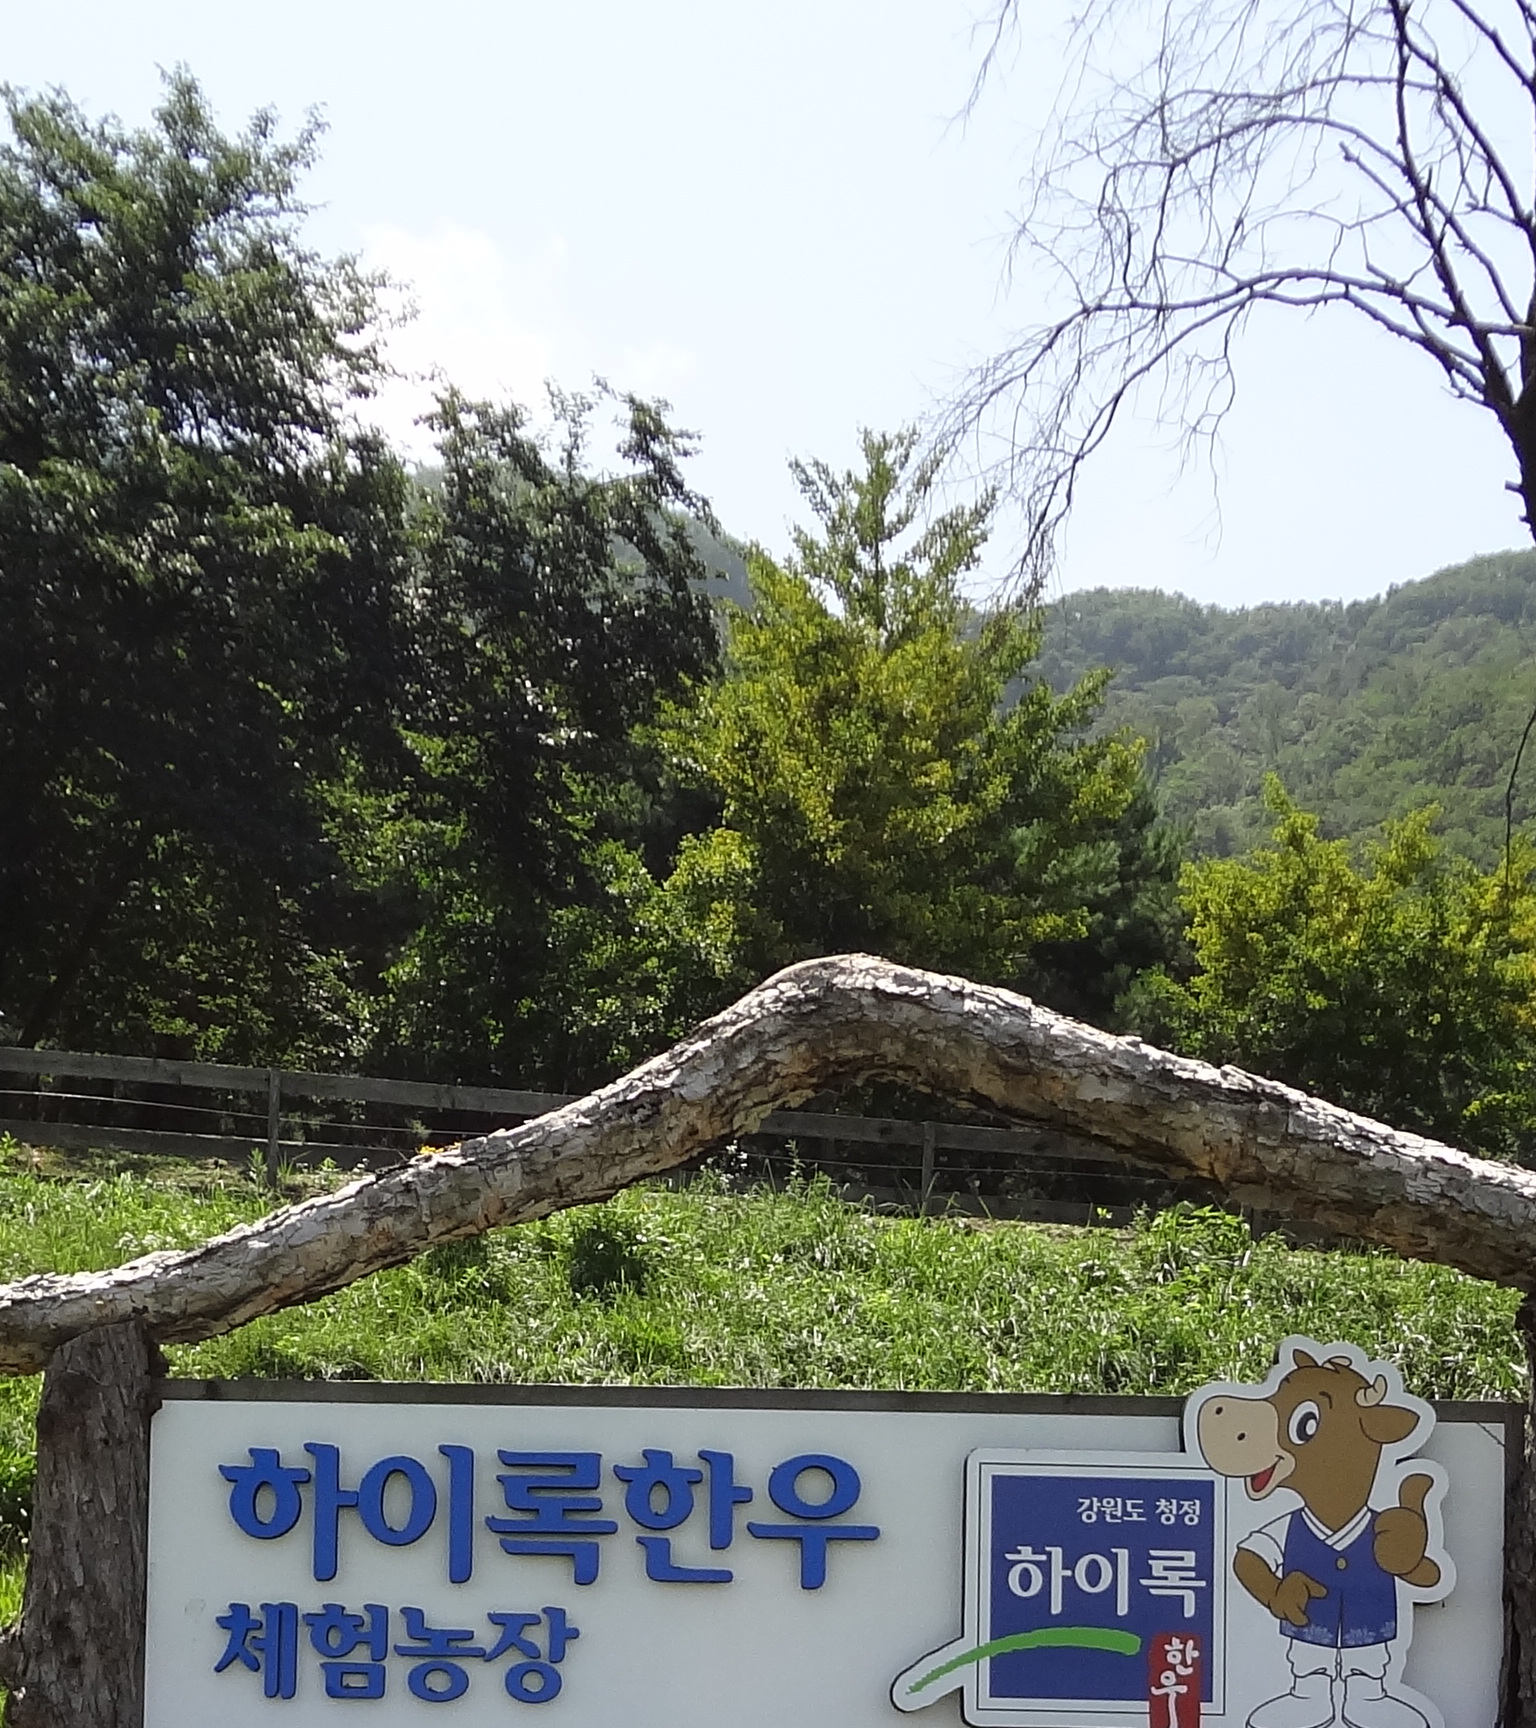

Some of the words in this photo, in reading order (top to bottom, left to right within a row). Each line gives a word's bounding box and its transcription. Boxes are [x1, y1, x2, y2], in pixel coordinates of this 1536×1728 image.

[217, 1442, 881, 1591] 하이록한우
[1076, 1496, 1147, 1524] 강원도
[1155, 1498, 1201, 1526] 청정
[1004, 1545, 1207, 1618] 하이록
[213, 1601, 581, 1705] 체험농장
